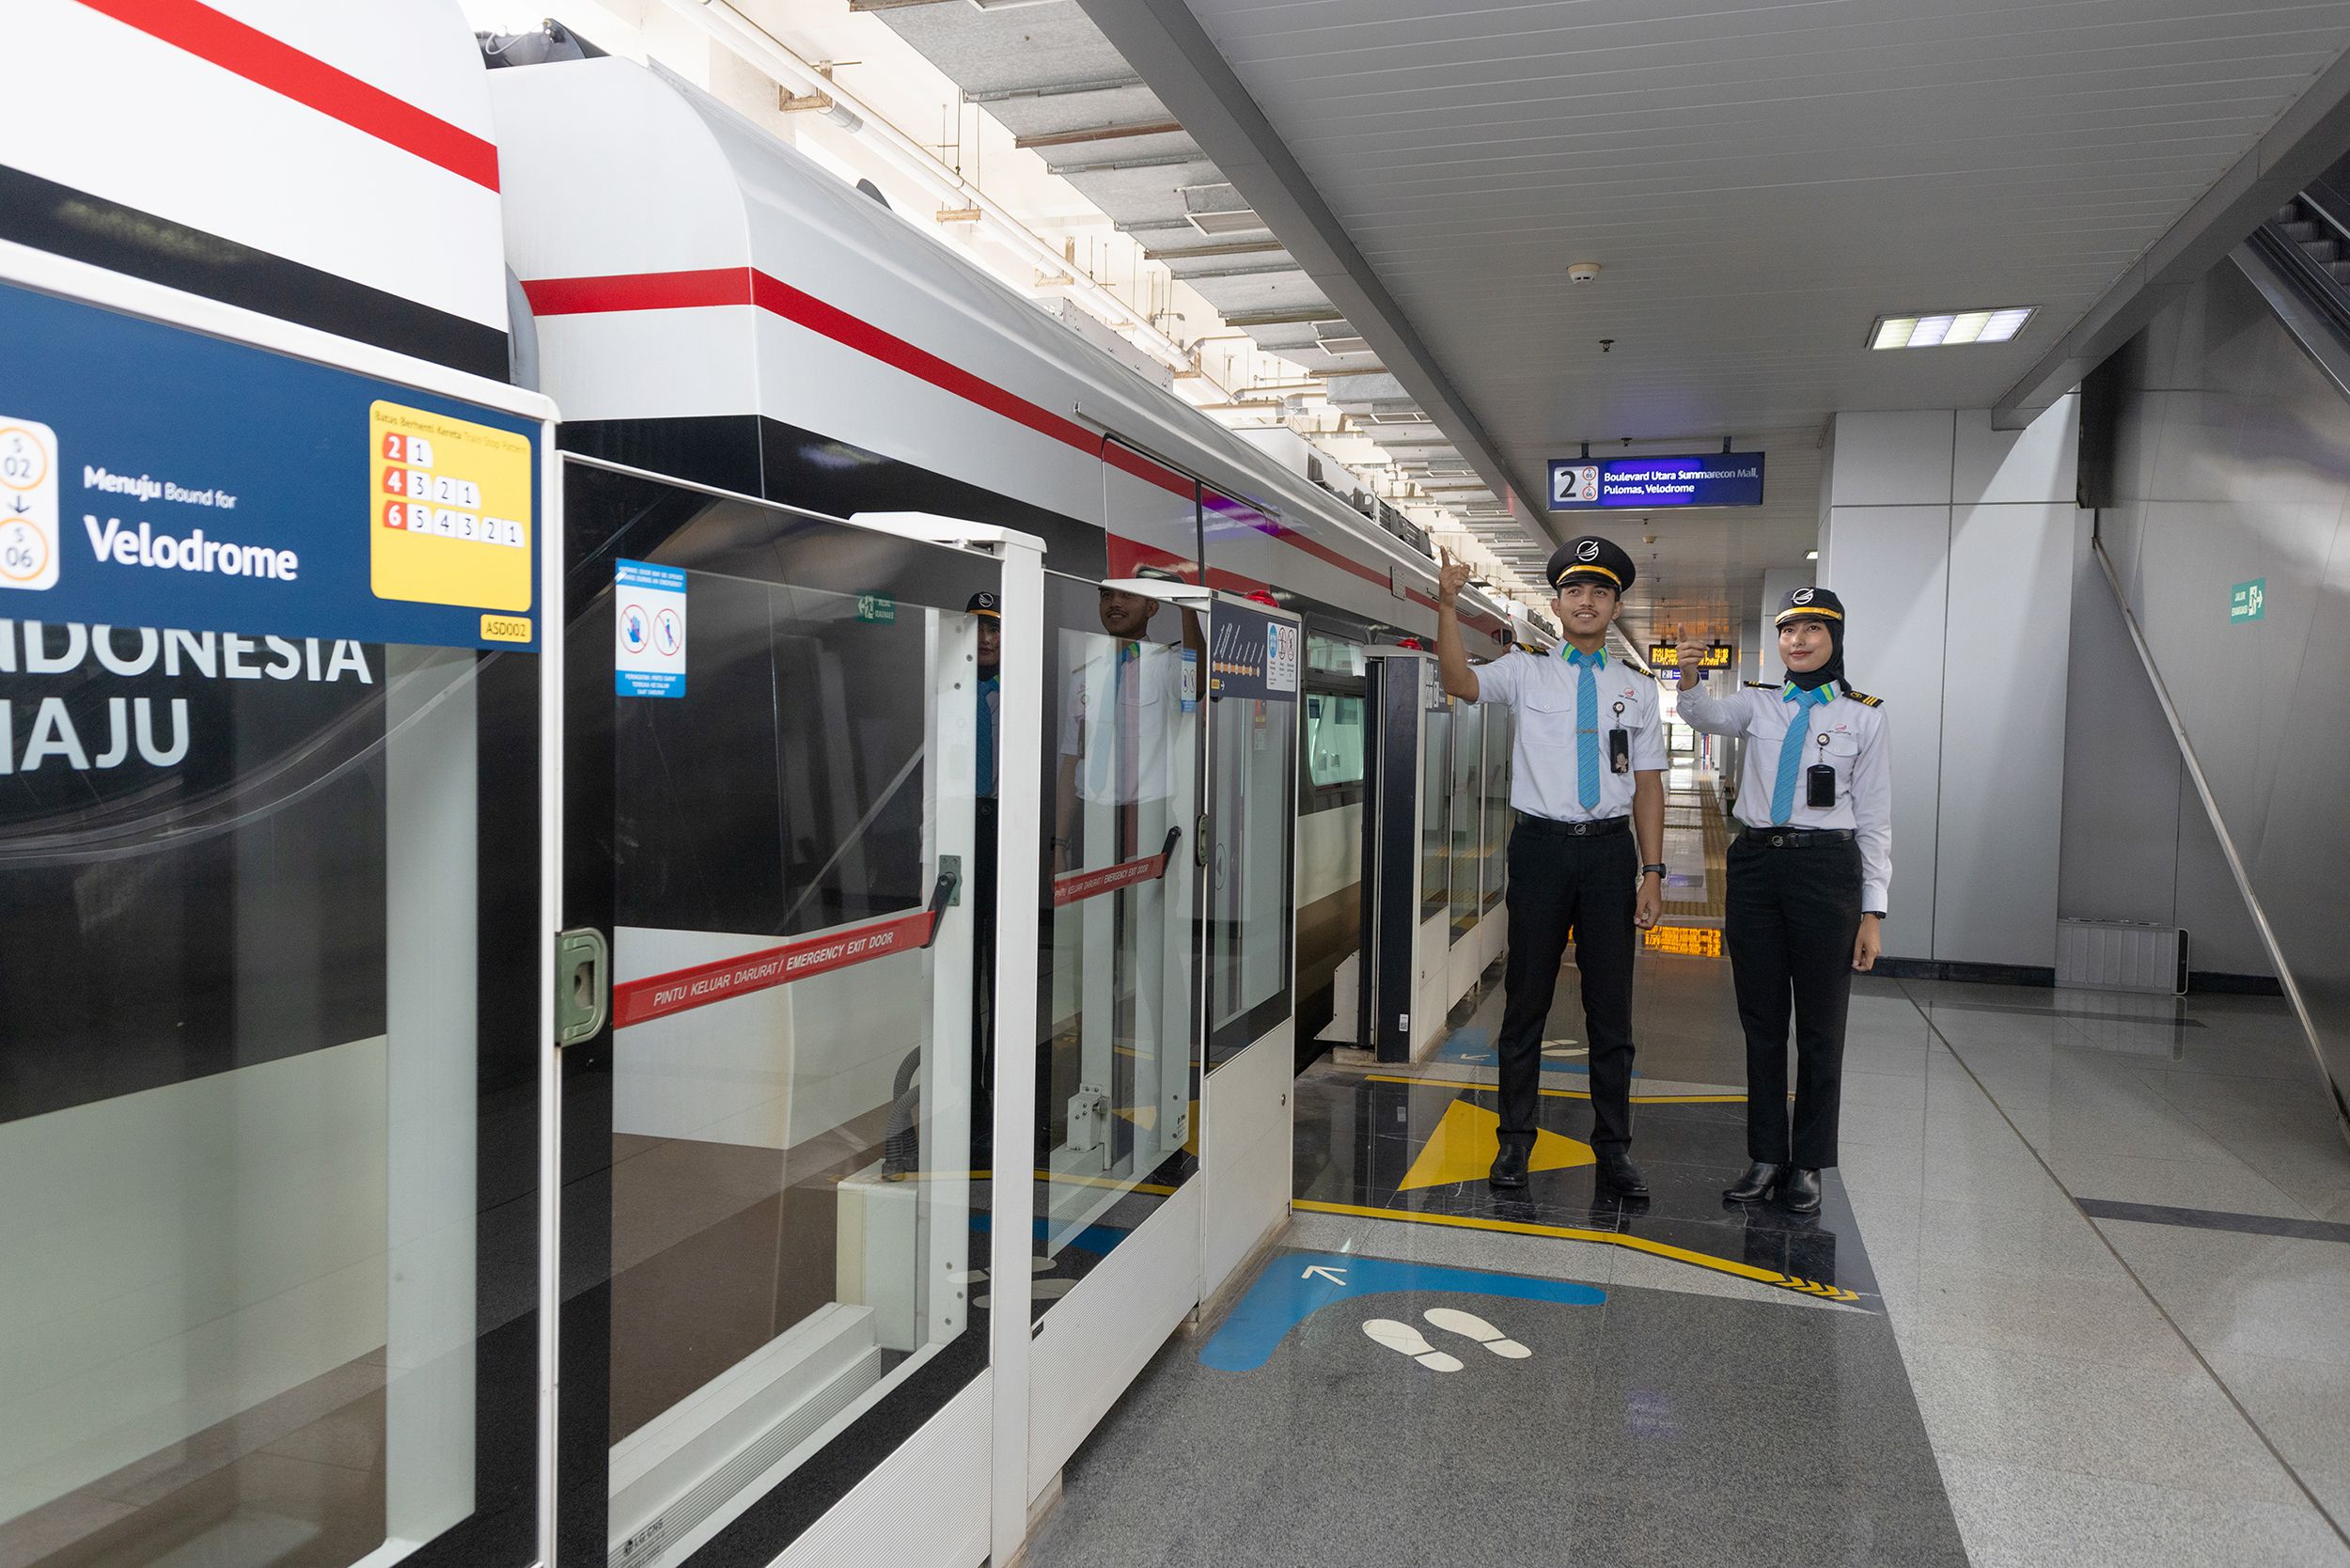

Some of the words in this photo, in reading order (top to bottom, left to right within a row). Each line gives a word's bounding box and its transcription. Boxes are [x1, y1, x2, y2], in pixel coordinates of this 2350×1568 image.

[387, 435, 400, 459] 2
[415, 444, 424, 463] 1
[4, 457, 30, 478] 02
[1604, 472, 1650, 481] Boulevard
[1652, 471, 1676, 480] Utara
[1678, 470, 1735, 480] Summarecon
[1737, 467, 1759, 478] Mall,
[84, 465, 161, 502] Menuju
[164, 482, 213, 507] Bound
[215, 490, 237, 509] for
[387, 470, 402, 493] 4
[415, 477, 424, 494] 3
[441, 481, 448, 499] 2
[464, 486, 472, 504] 1
[1559, 470, 1576, 498] 2
[1604, 484, 1644, 494] Pulomas,
[1645, 483, 1695, 494] Velodrome
[387, 505, 402, 526] 6
[415, 510, 424, 528] 5
[441, 514, 449, 532] 4
[464, 518, 473, 535] 3
[488, 522, 495, 539] 2
[509, 525, 517, 542] 1
[6, 547, 33, 568] 06
[84, 514, 298, 580] Velodrome
[486, 621, 526, 638] ASD002
[0, 698, 188, 775] AJU
[653, 986, 686, 1007] PINTU
[690, 974, 730, 996] KELUAR
[786, 944, 844, 971] EMERGENCY
[847, 938, 867, 956] EXIT
[869, 932, 894, 950] DOOR
